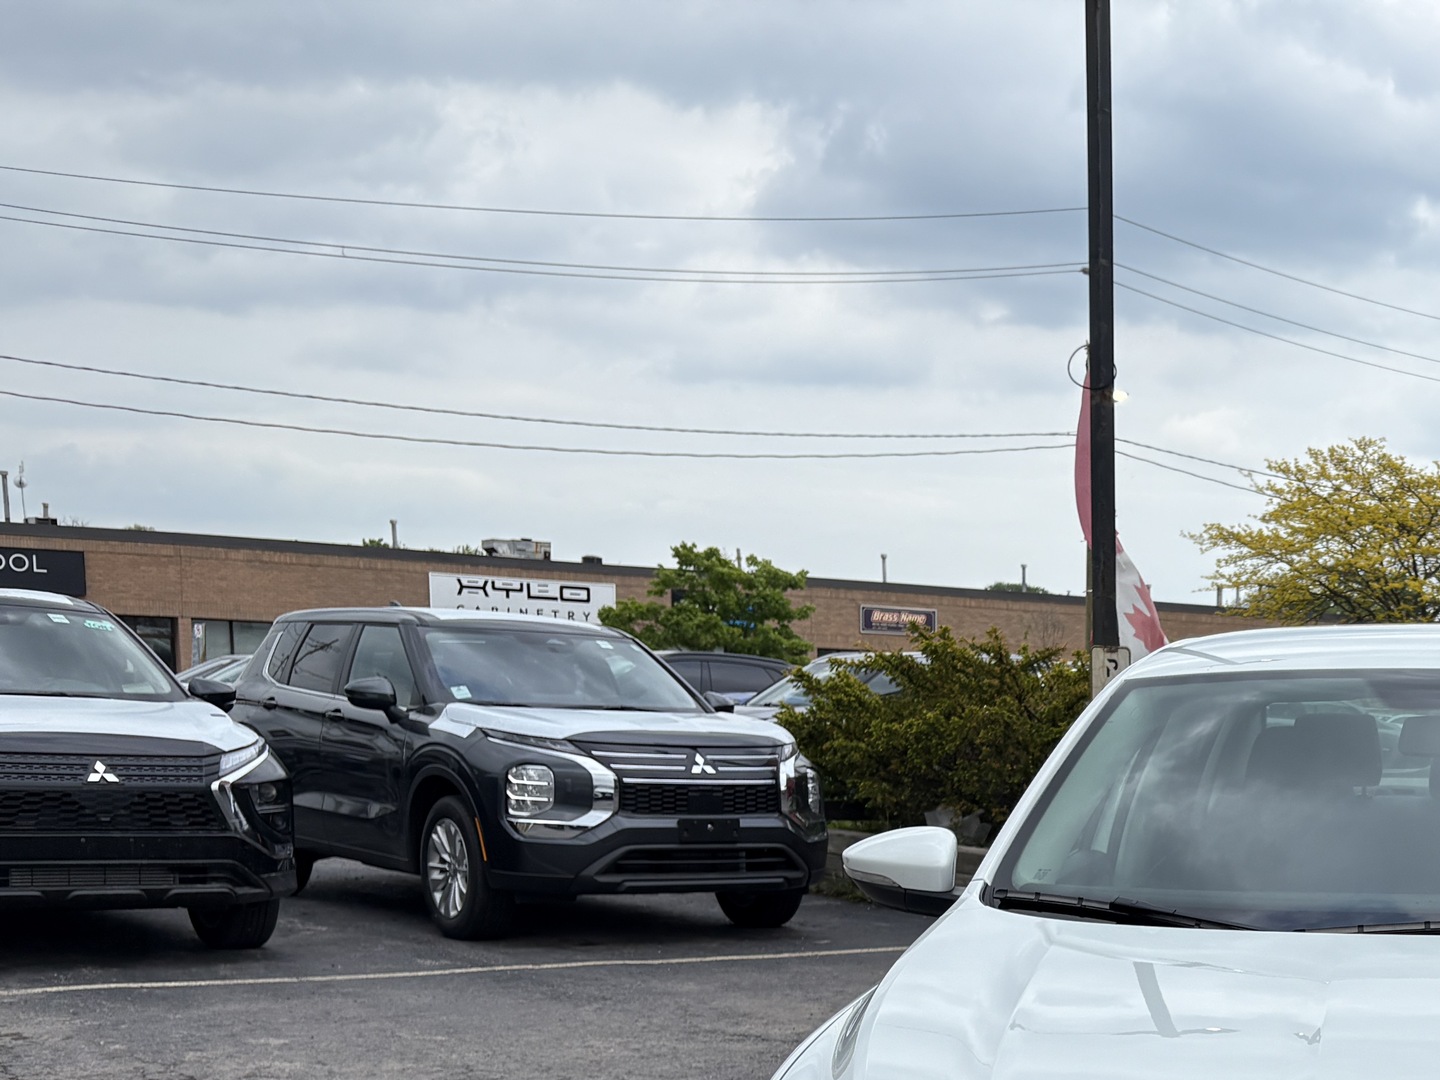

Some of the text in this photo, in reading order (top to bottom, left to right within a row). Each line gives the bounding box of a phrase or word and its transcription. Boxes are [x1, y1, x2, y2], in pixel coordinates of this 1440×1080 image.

[0, 553, 48, 574] OL
[456, 578, 592, 603] XYLO
[871, 609, 899, 623] Brass
